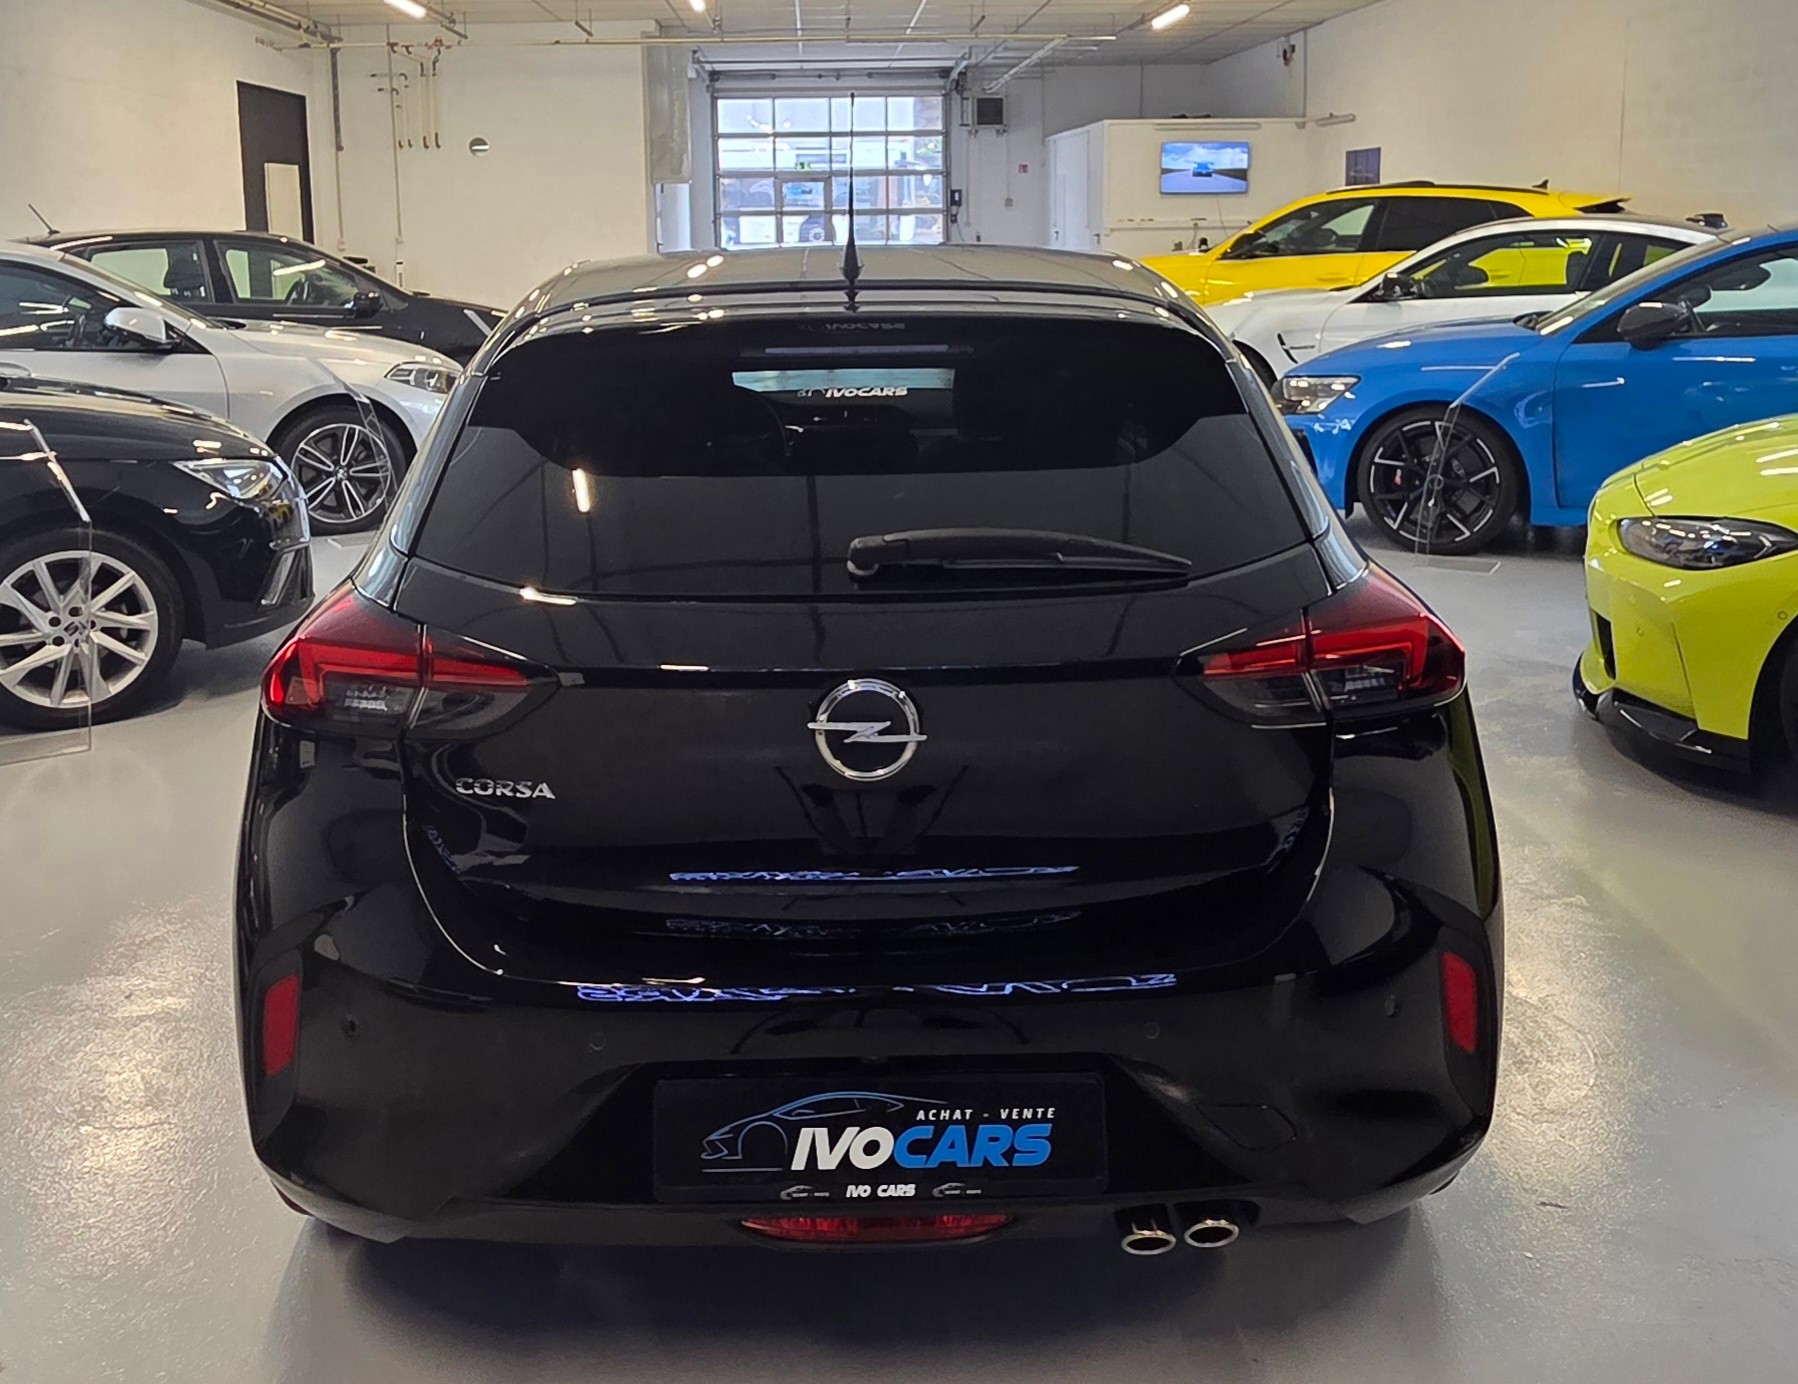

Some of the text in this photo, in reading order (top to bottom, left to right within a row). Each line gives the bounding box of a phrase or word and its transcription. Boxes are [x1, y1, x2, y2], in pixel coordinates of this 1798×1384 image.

[825, 386, 908, 398] IVOCARS
[456, 777, 556, 799] CORSA
[916, 1109, 974, 1120] ACHAT
[1000, 1107, 1056, 1119] VENTE
[845, 1184, 916, 1198] IVO CARS
